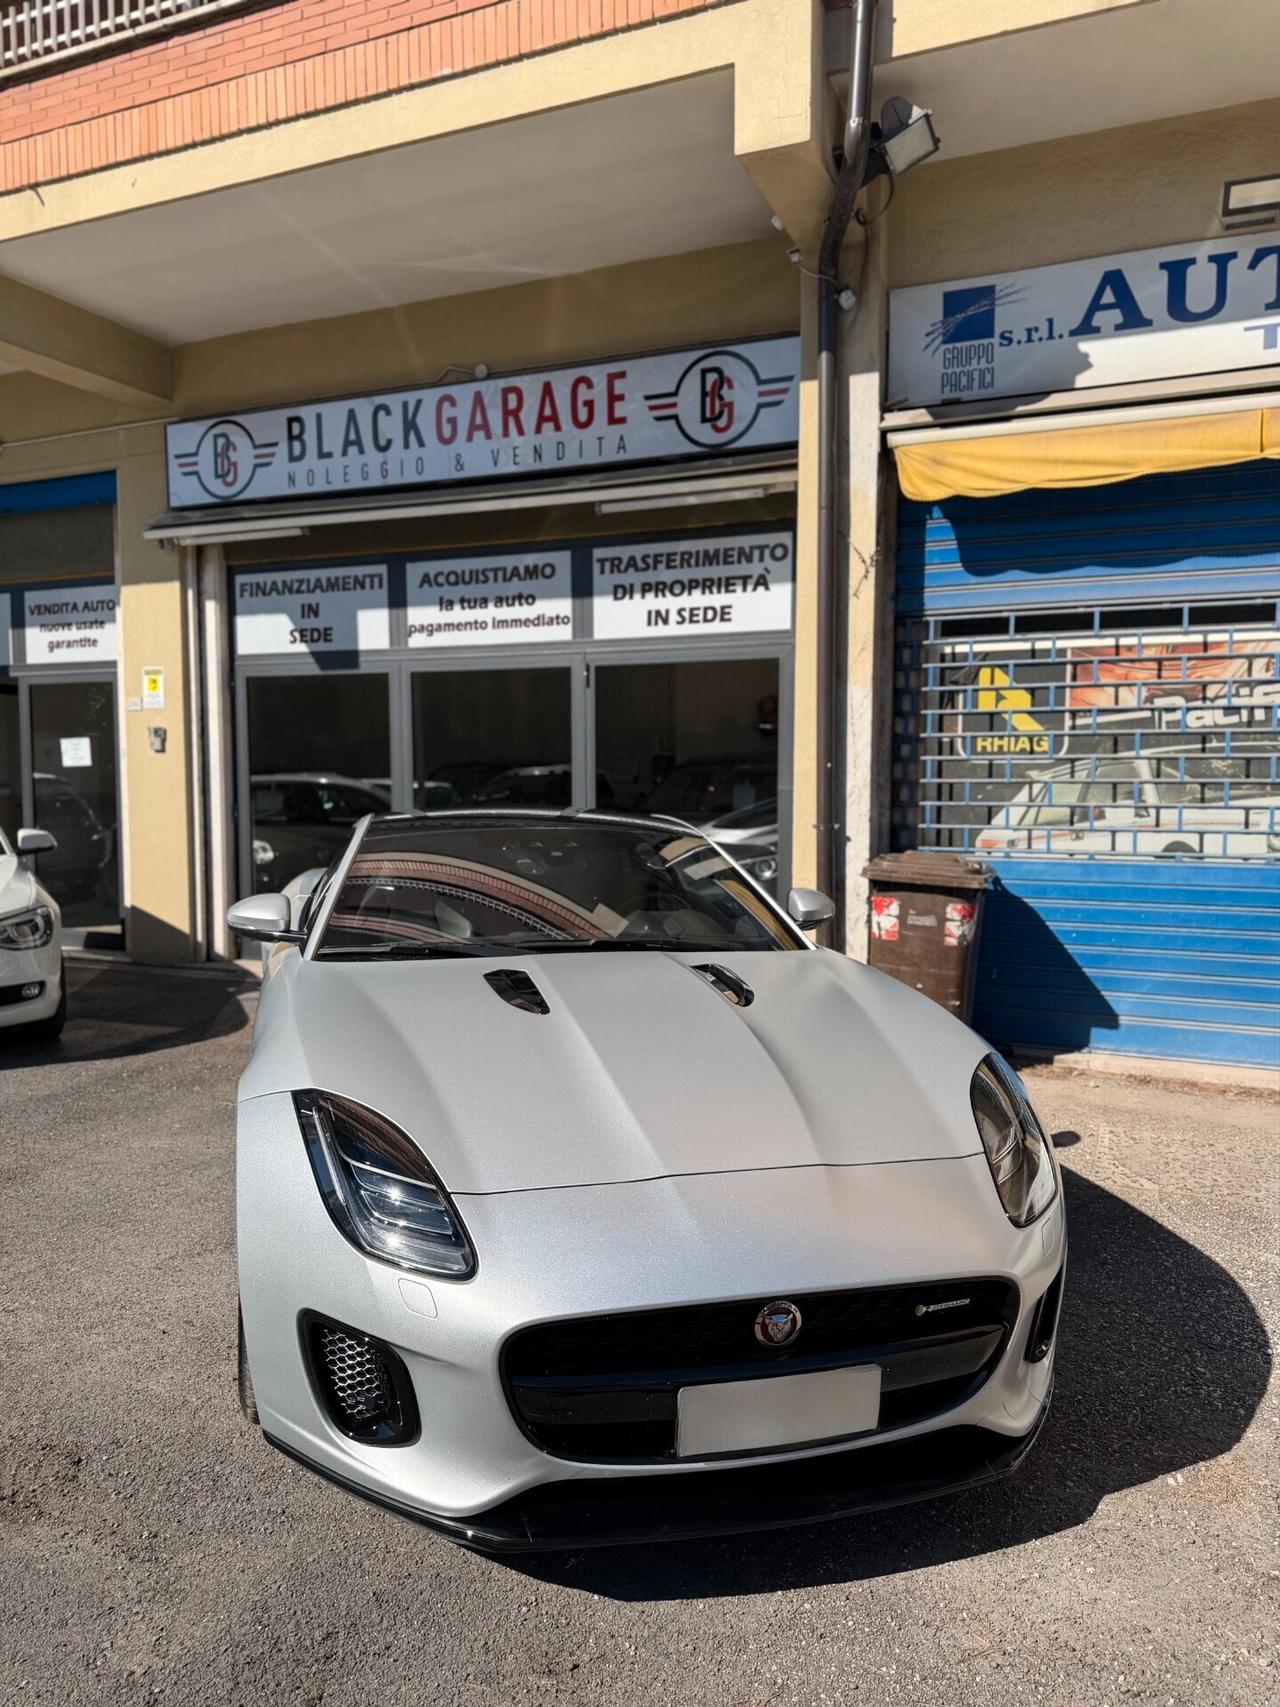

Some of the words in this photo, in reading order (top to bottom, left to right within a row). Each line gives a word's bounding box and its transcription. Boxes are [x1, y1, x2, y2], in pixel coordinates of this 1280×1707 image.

[943, 342, 994, 370] GRUPPO
[941, 366, 994, 394] PACIFICI
[288, 456, 424, 488] NOLEGGIO
[455, 453, 465, 472] &
[491, 434, 627, 468] VENDITA
[596, 542, 790, 575] TRASFERIMENTO
[239, 573, 384, 598] FINANZIAMENTI
[418, 563, 556, 589] ACQUISTIAMO
[613, 583, 635, 601] DI
[641, 567, 771, 599] PROPRIETÀ
[28, 602, 79, 616] VENDITA
[82, 600, 116, 612] AUTO
[301, 602, 320, 619] IN
[459, 595, 489, 611] tua
[493, 592, 536, 608] auto
[40, 623, 72, 632] nuove
[75, 619, 105, 630] usate
[646, 609, 670, 627] IN
[676, 605, 733, 625] SEDE
[289, 626, 334, 645] SEDE
[408, 618, 488, 638] pagamento
[48, 637, 98, 653] garantite
[976, 735, 1049, 753] RHIAG
